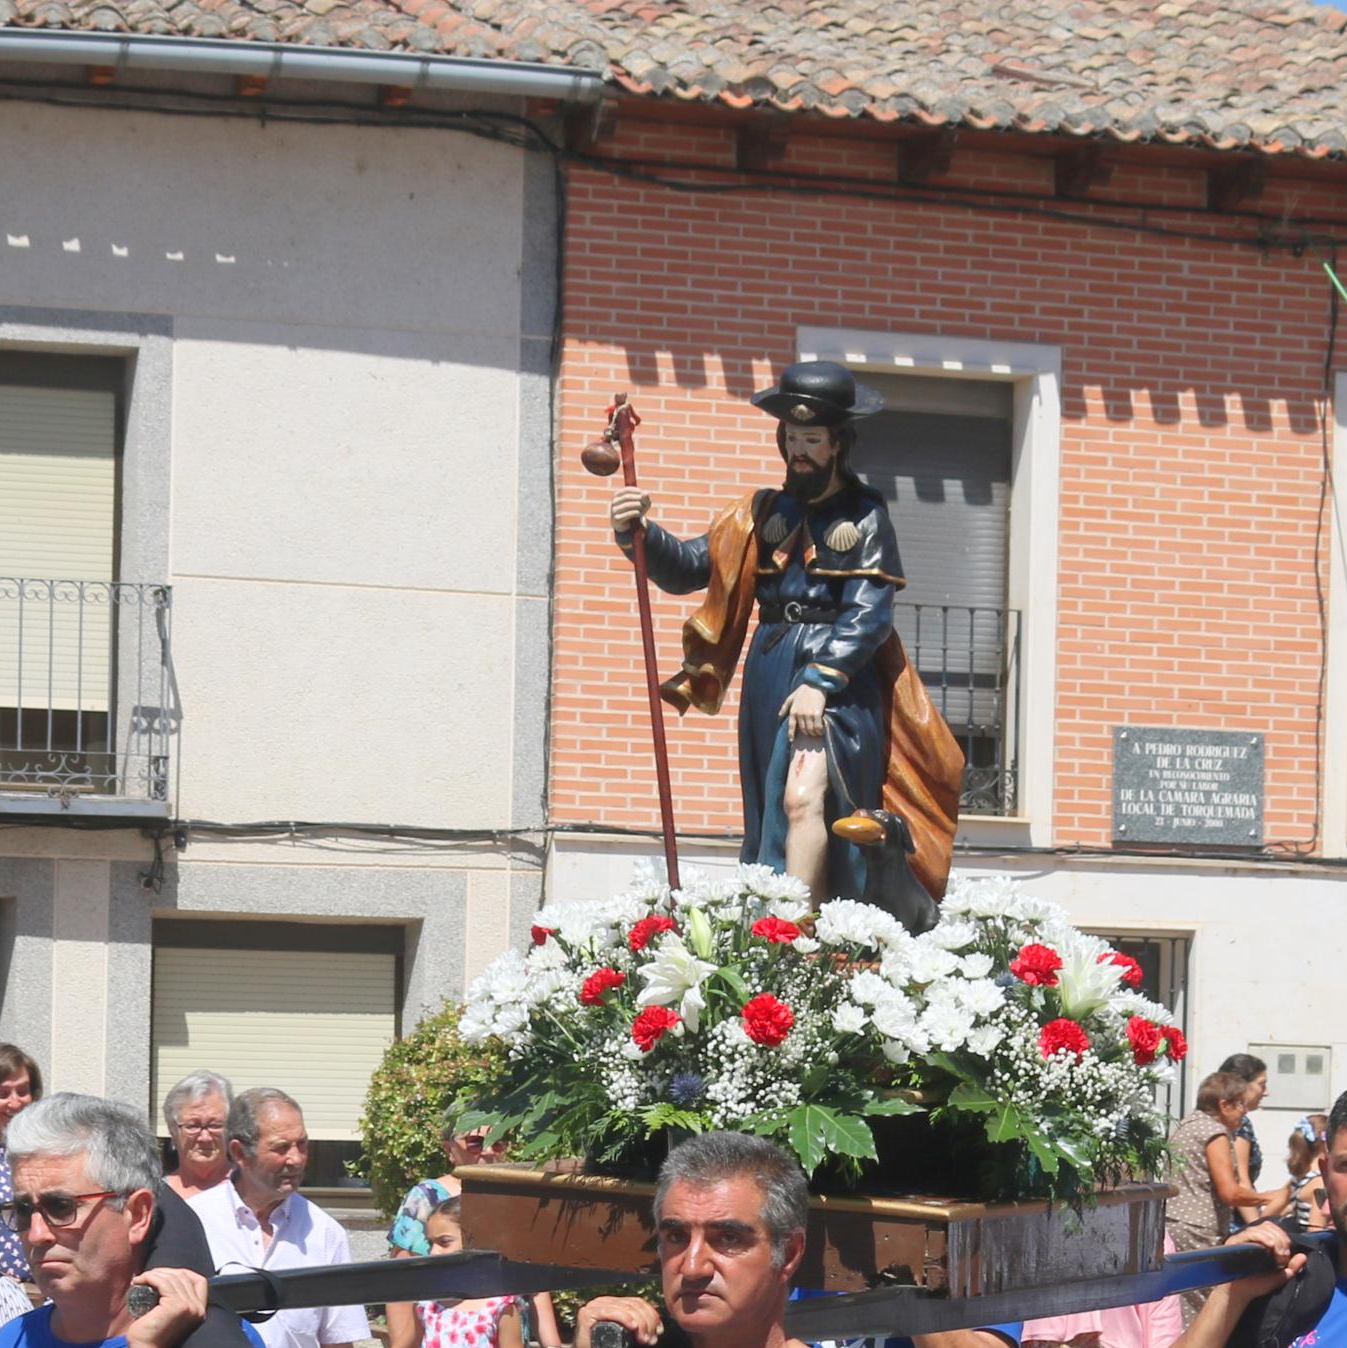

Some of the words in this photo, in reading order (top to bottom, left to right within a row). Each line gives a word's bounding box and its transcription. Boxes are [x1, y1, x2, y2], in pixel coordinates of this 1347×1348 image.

[1133, 742, 1141, 755] A
[1145, 743, 1181, 756] PEDRO
[1186, 745, 1247, 759] RODRIGUEZ
[1156, 757, 1171, 769] DE
[1176, 757, 1190, 769] LA
[1195, 758, 1223, 770] CRUZ
[1160, 780, 1176, 789] POR
[1192, 782, 1219, 791] LABOR
[1120, 789, 1136, 801] DE
[1140, 789, 1154, 801] LA
[1159, 790, 1205, 804] CAMARA
[1211, 793, 1257, 807] AGRARIA
[1121, 802, 1156, 815] LOCAL
[1161, 804, 1175, 816] DE
[1180, 804, 1256, 820] TORQUEMADA
